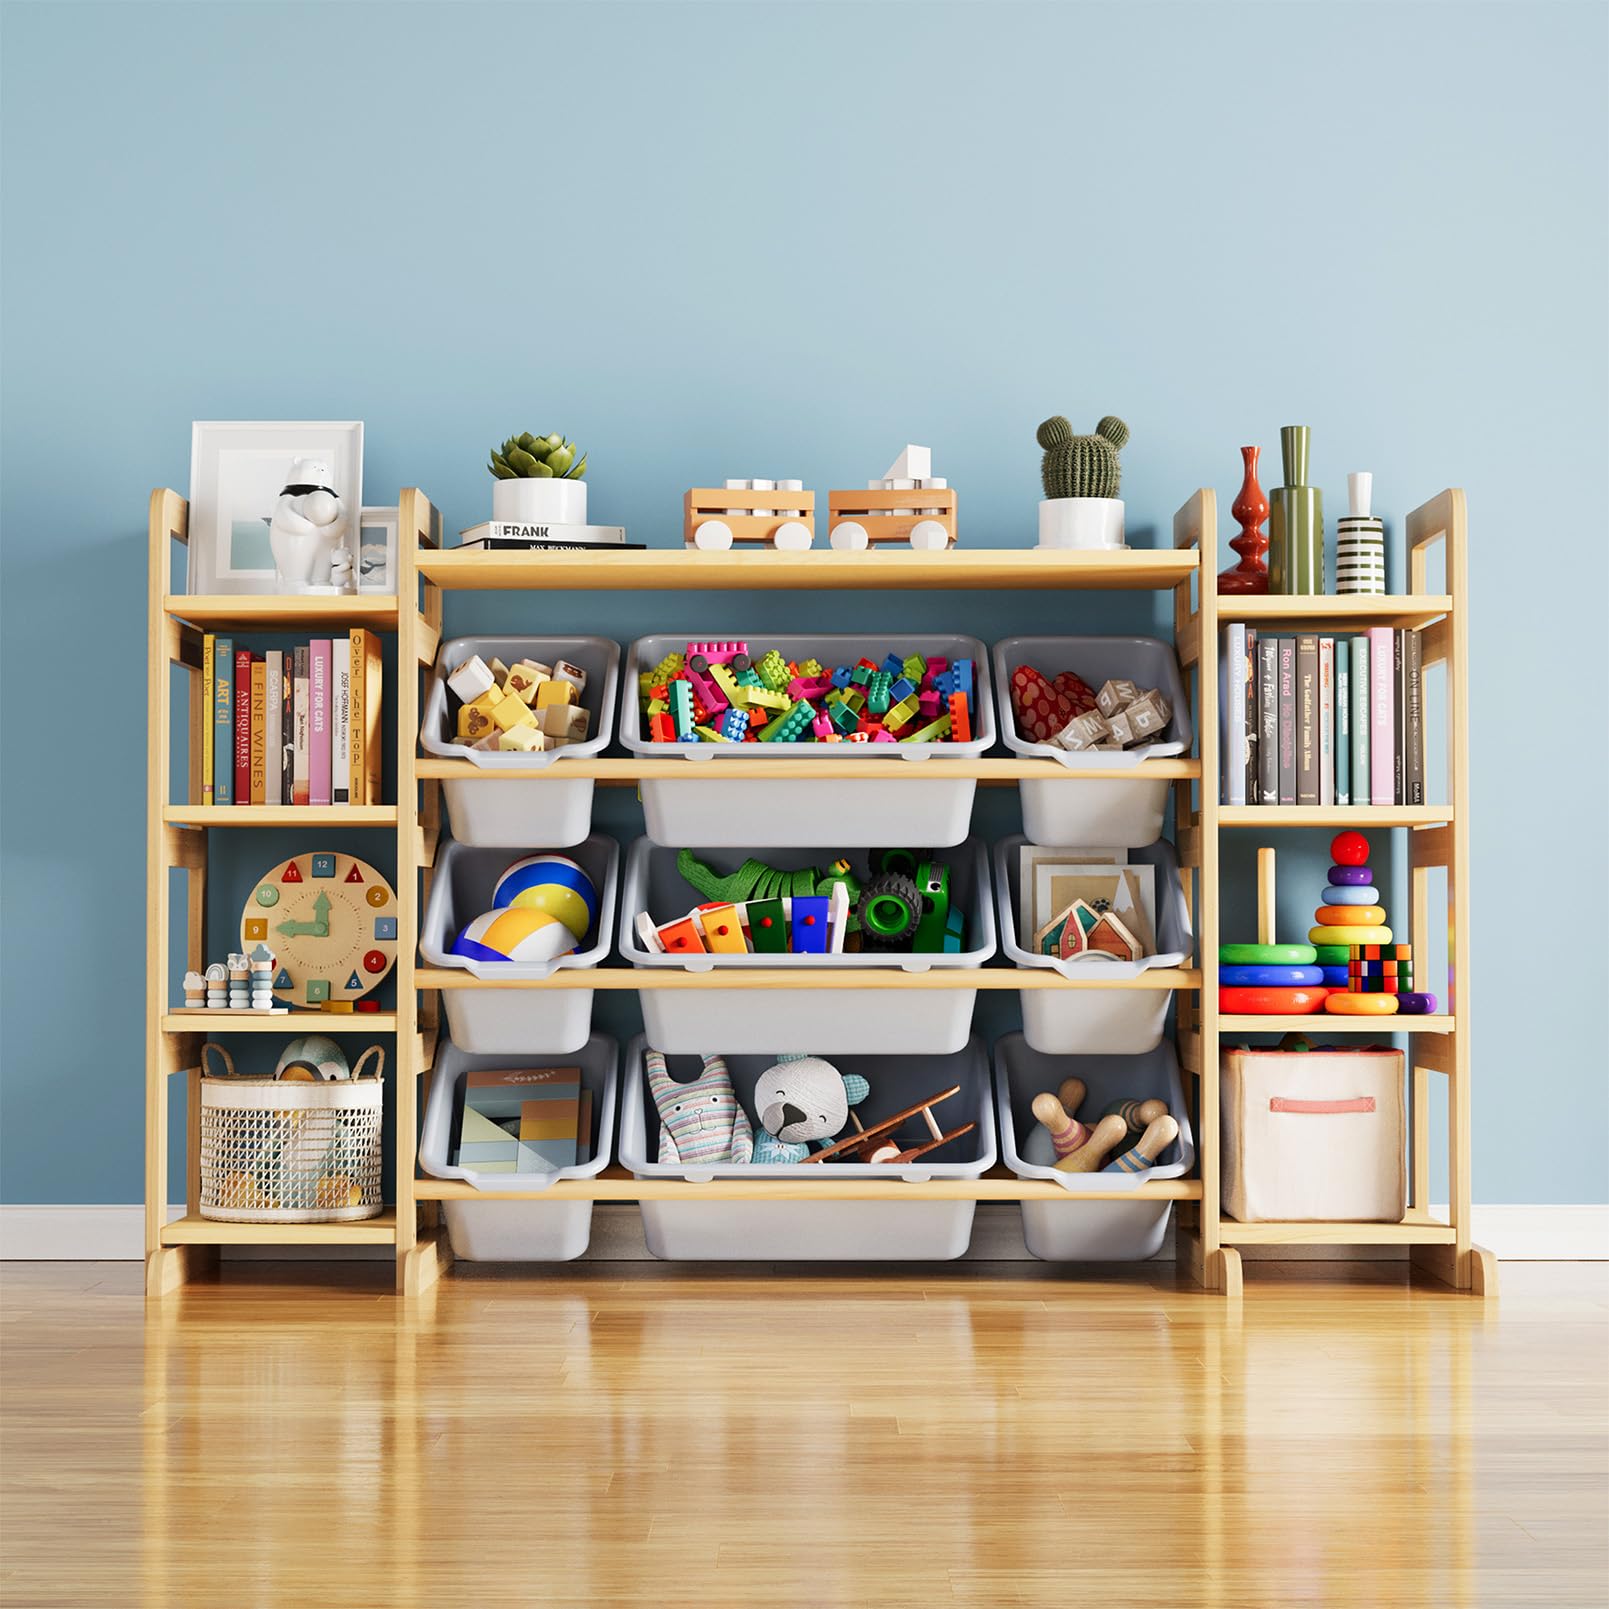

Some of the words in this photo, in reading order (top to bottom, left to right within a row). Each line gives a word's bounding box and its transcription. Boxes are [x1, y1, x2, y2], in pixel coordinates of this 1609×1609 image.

[503, 525, 549, 537] FRANK
[353, 636, 361, 676] Over
[1282, 648, 1292, 670] Ron
[314, 656, 324, 690] LUXURY
[1304, 674, 1312, 688] The
[1359, 648, 1367, 695] EXECUTIVE
[1409, 670, 1420, 689] ON
[217, 679, 230, 705] ART
[269, 670, 278, 714] SCARPA
[1282, 672, 1292, 696] Arad
[254, 682, 263, 721] FINE
[314, 691, 324, 709] FOR
[1304, 689, 1312, 723] Godfather
[314, 710, 324, 732] CATS
[1359, 697, 1367, 735] ESCAPES
[240, 690, 249, 768] ANTIQUAIRES
[1303, 726, 1311, 749] Family
[253, 729, 263, 788] WINES
[1413, 782, 1421, 803] MoMA
[317, 860, 328, 868] 12
[262, 890, 272, 898] 10
[252, 926, 259, 934] 9
[382, 924, 388, 932] 3
[314, 987, 320, 995] 6
[351, 979, 357, 987] 5
